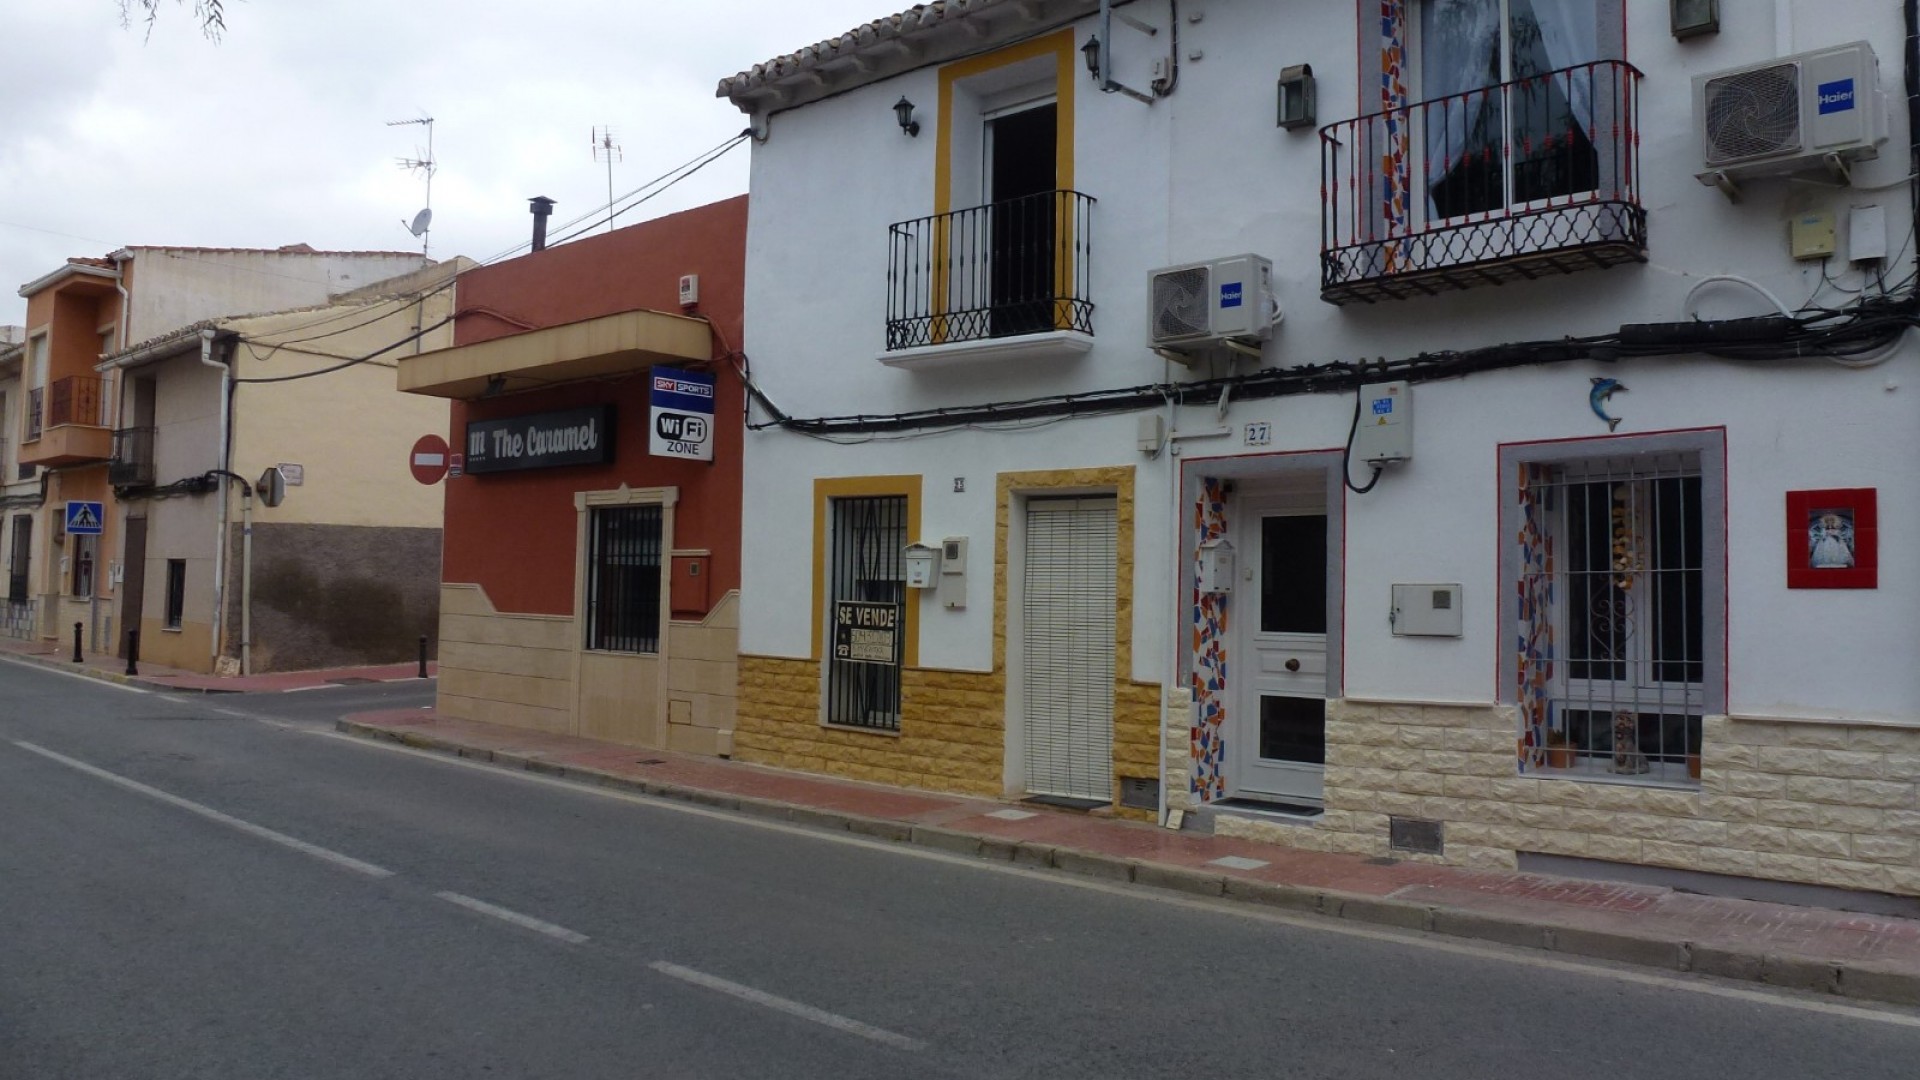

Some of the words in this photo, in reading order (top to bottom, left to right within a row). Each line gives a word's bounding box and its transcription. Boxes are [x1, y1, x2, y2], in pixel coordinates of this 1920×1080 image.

[1818, 91, 1853, 104] Haier
[1221, 291, 1242, 300] Haier
[657, 380, 674, 390] SKY
[677, 383, 710, 395] SPORTS
[492, 428, 524, 459] The
[527, 417, 598, 457] Caramel
[1249, 426, 1267, 441] 27
[667, 441, 699, 455] ZONE
[839, 606, 853, 625] SE
[856, 606, 895, 628] VENDE
